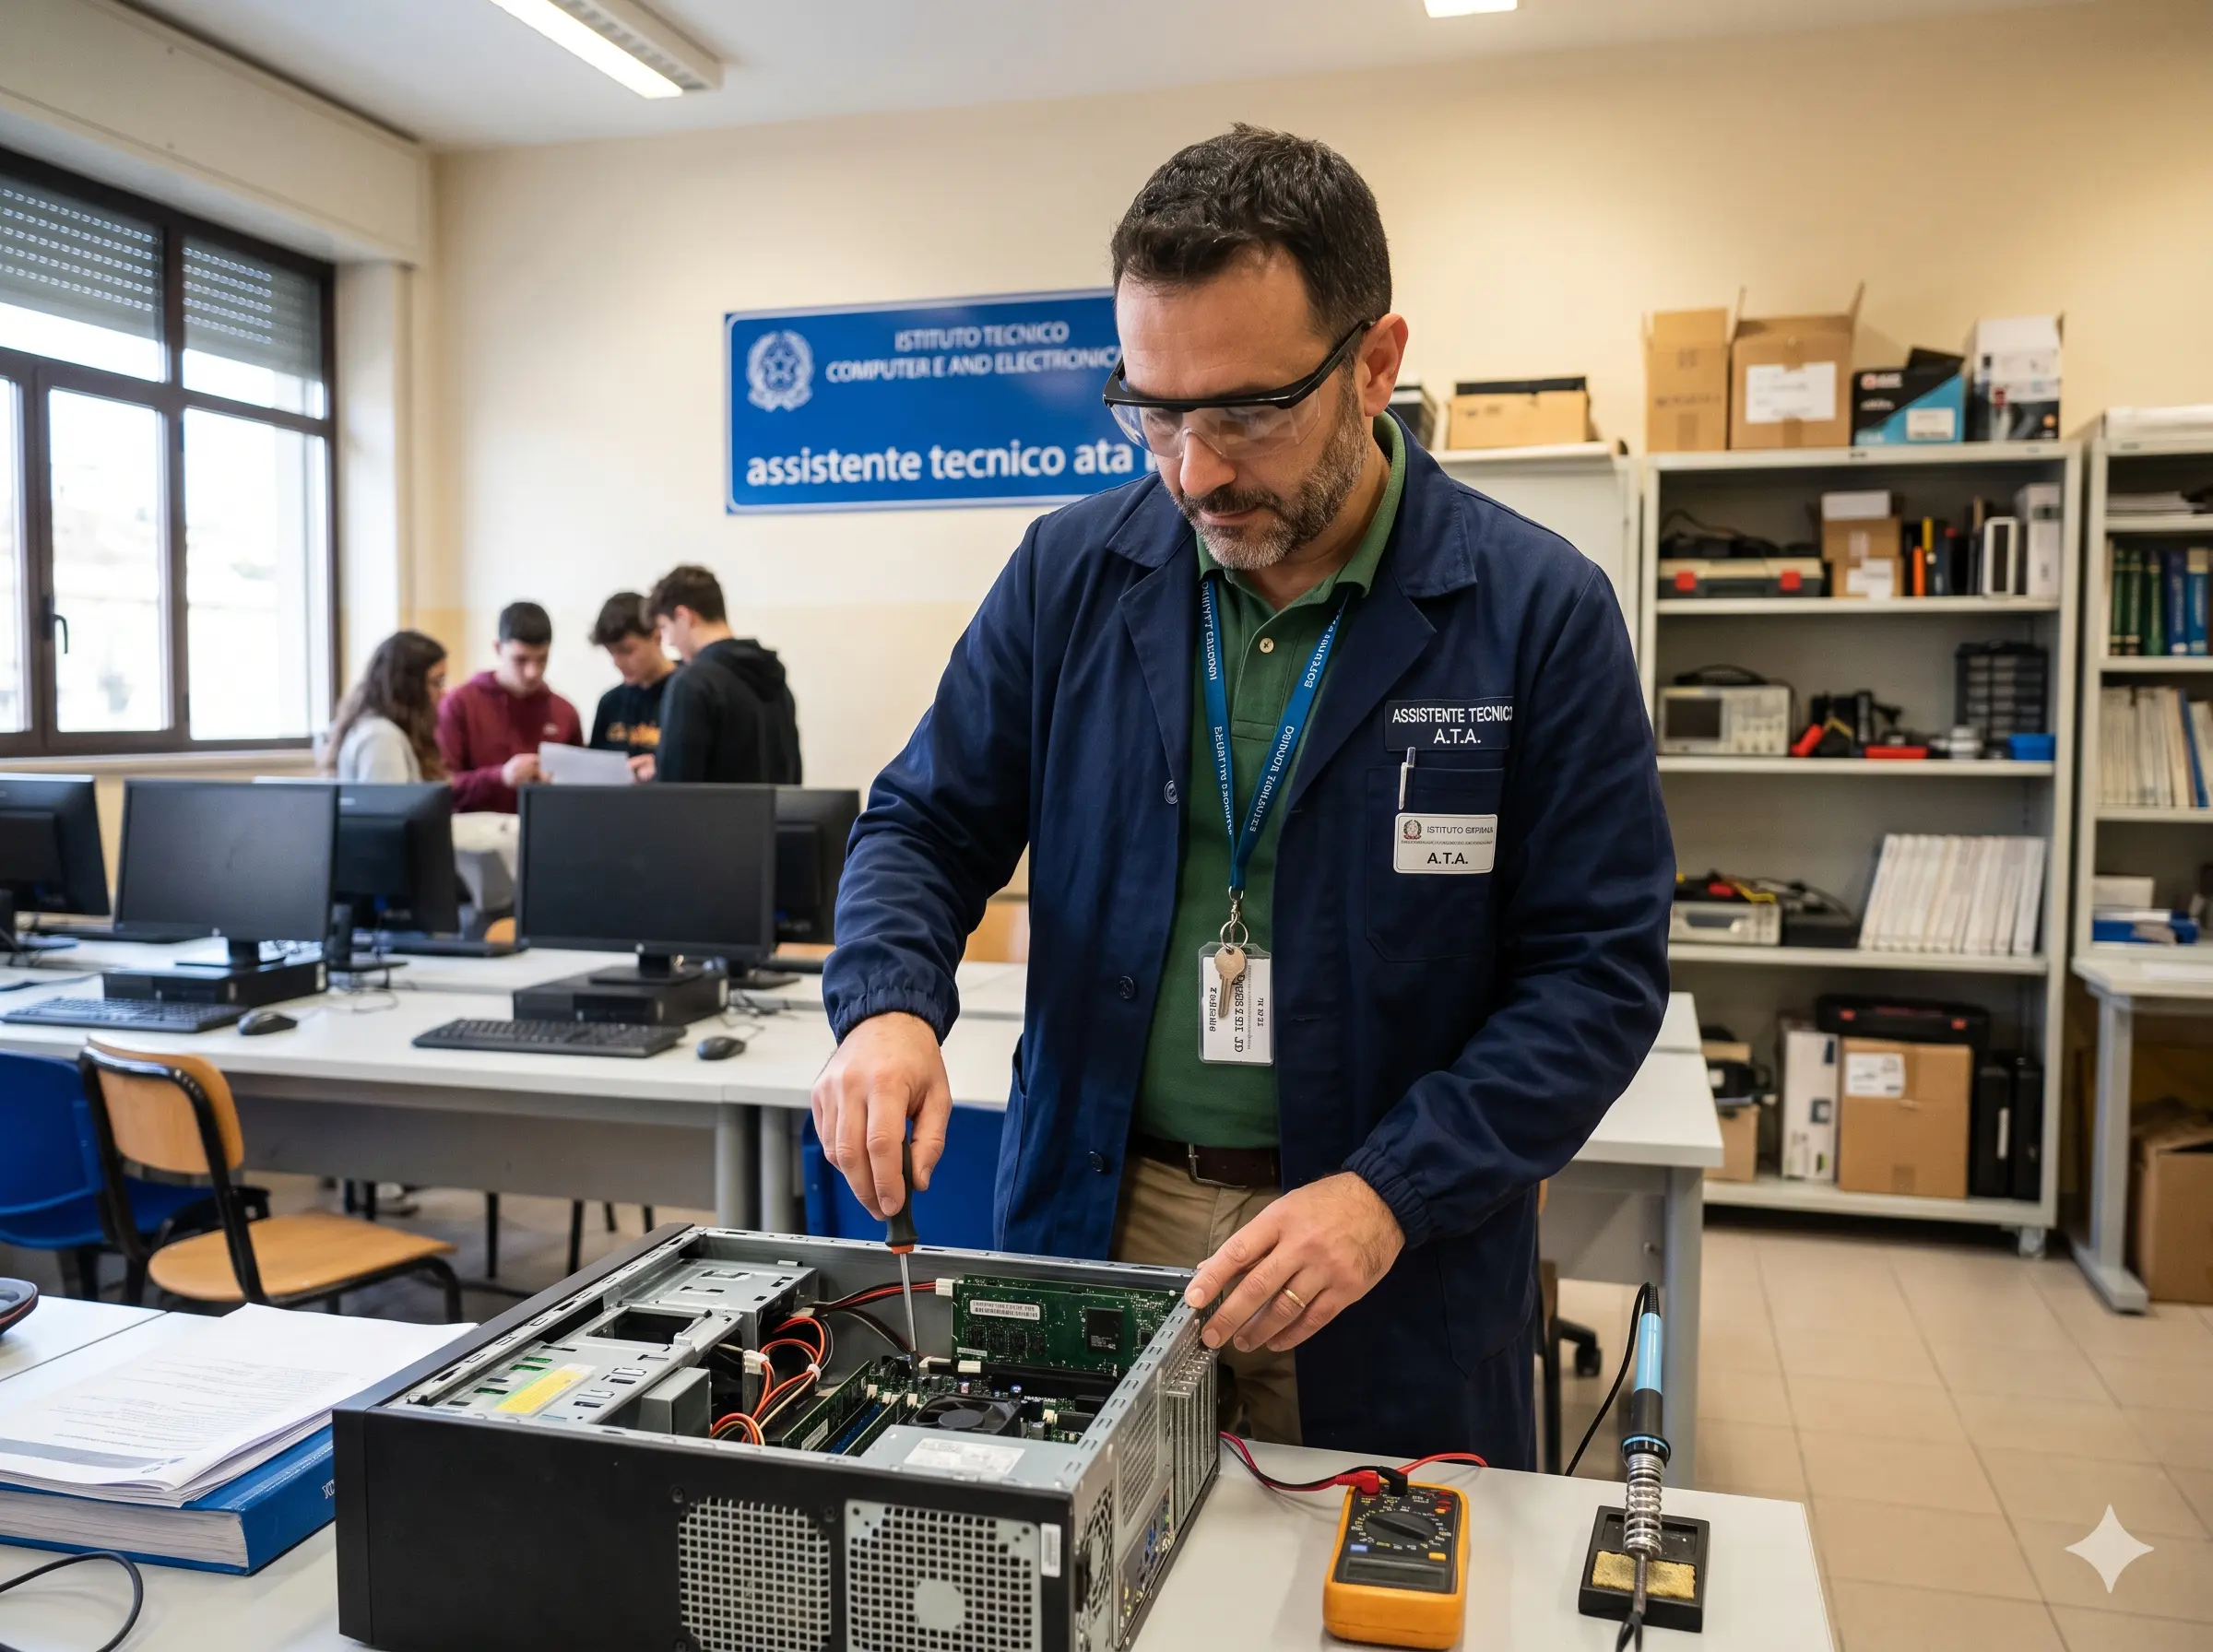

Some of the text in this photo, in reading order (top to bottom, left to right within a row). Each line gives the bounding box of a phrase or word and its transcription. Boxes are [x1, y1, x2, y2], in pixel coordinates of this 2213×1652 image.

[746, 446, 922, 486] assistente
[929, 439, 1066, 480] tecnico
[1072, 437, 1133, 476] ata
[1391, 707, 1465, 724] ASSISTENTE
[1433, 728, 1482, 744] A.T.A.
[1426, 852, 1469, 865] A.T.A.
